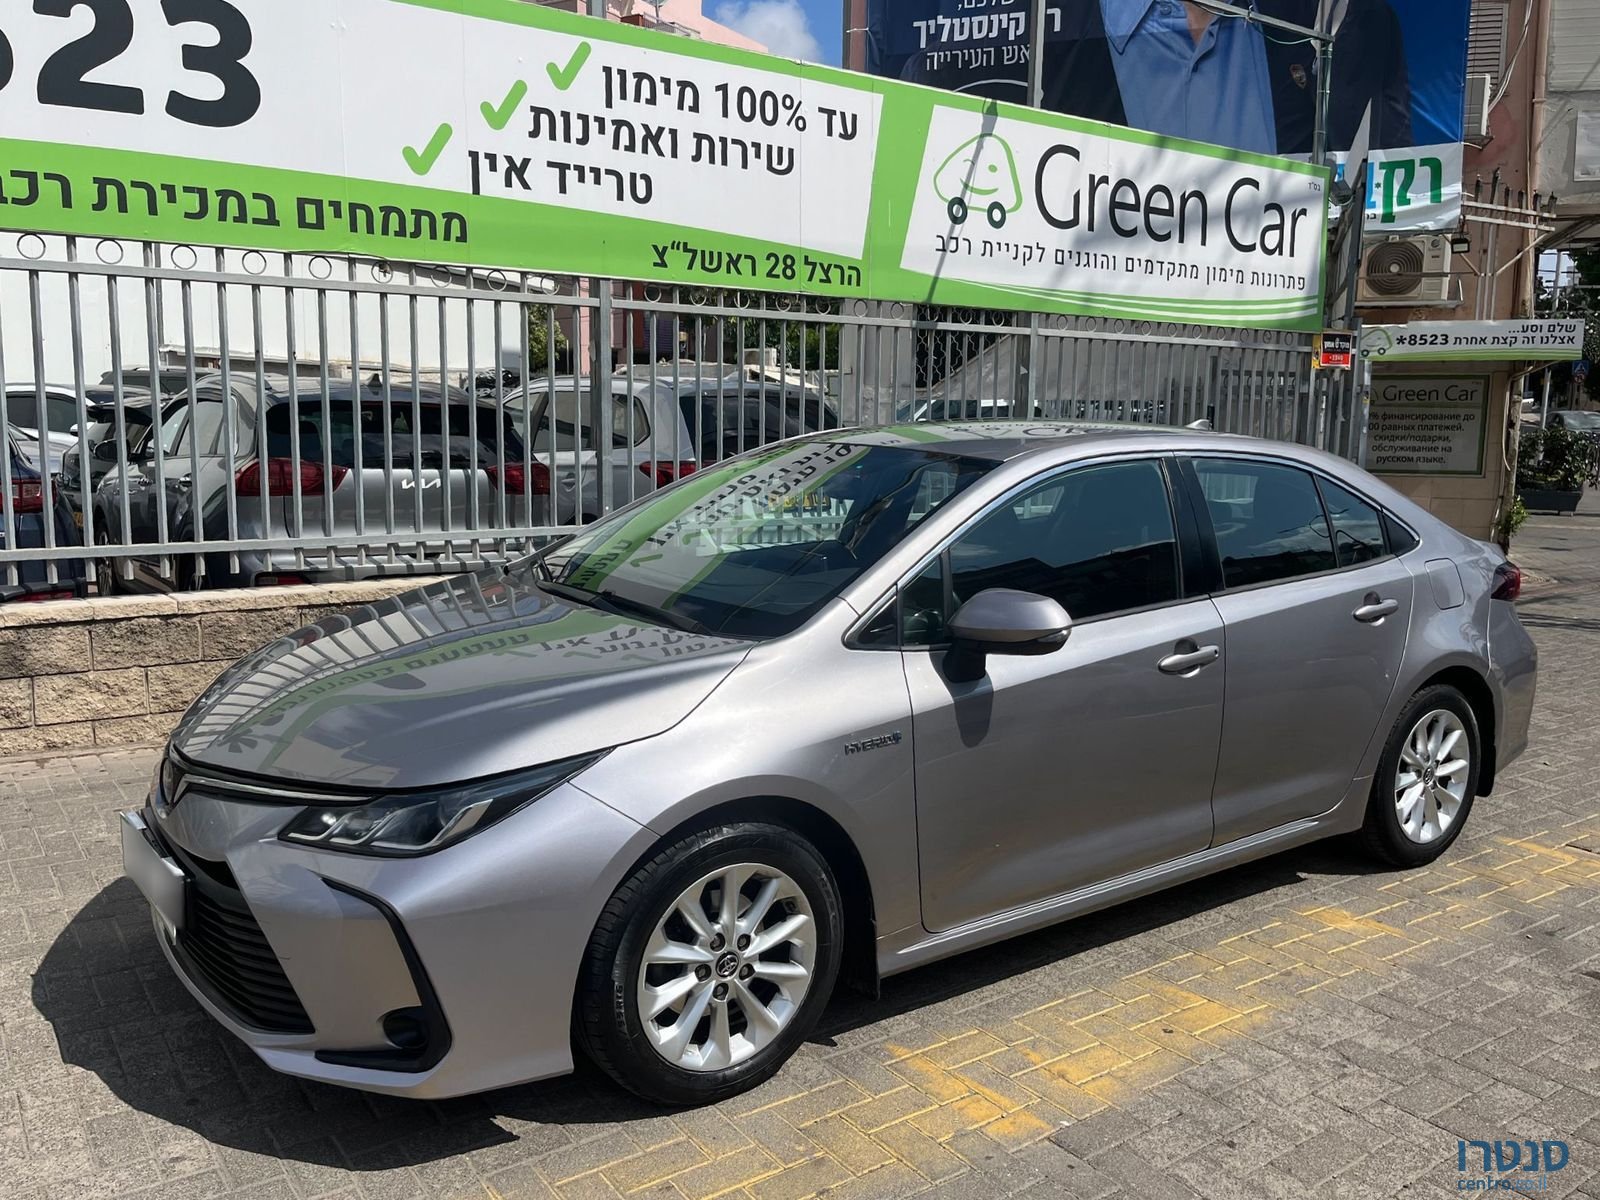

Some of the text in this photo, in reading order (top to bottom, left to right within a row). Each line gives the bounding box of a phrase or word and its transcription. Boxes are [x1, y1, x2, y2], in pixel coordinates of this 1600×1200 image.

[912, 12, 1026, 48] קינסטליך
[0, 0, 261, 127] 23
[926, 45, 1031, 71] אש העירייה
[602, 65, 858, 141] עד 100% מימון
[528, 105, 795, 176] שירות ואמינות
[468, 150, 653, 205] טרייד אין
[91, 176, 281, 227] במכירת
[1034, 144, 1208, 247] Green
[1225, 177, 1308, 258] Car
[296, 197, 468, 244] מתמחים
[766, 252, 796, 281] 28
[803, 254, 861, 287] הרצל
[935, 234, 1305, 291] פתרונות מימון מתקדמים והוגנים לקניית רכב
[1522, 335, 1537, 345] זה
[1540, 334, 1576, 345] אצלנו
[1547, 321, 1577, 333] שלם
[1453, 336, 1488, 346] אחרת
[1490, 335, 1518, 348] קצת
[1382, 384, 1478, 401] Green Car
[1381, 410, 1462, 423] финансирование
[1462, 413, 1476, 423] до
[1381, 423, 1416, 433] равных
[1371, 443, 1440, 454] обслуживание
[1376, 455, 1414, 465] русском
